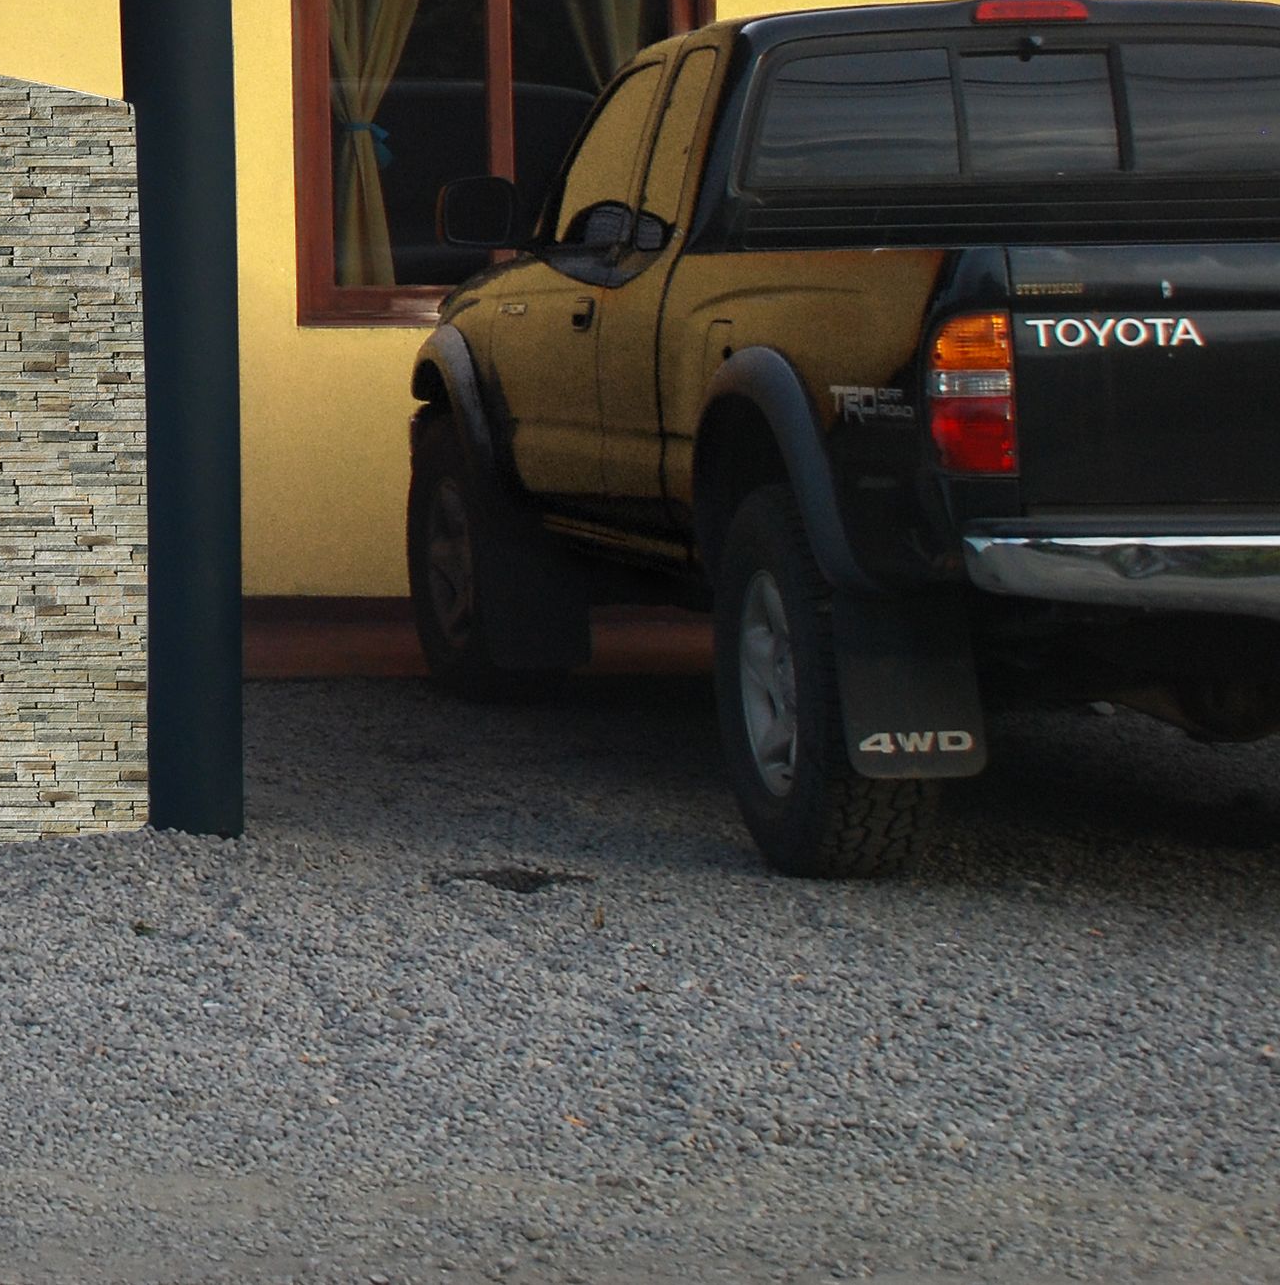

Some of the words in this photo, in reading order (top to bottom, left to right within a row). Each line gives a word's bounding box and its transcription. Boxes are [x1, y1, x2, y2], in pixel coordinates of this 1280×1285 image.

[1025, 318, 1204, 347] TOYOTA
[829, 385, 877, 424] TRD
[859, 731, 973, 753] 4WD
